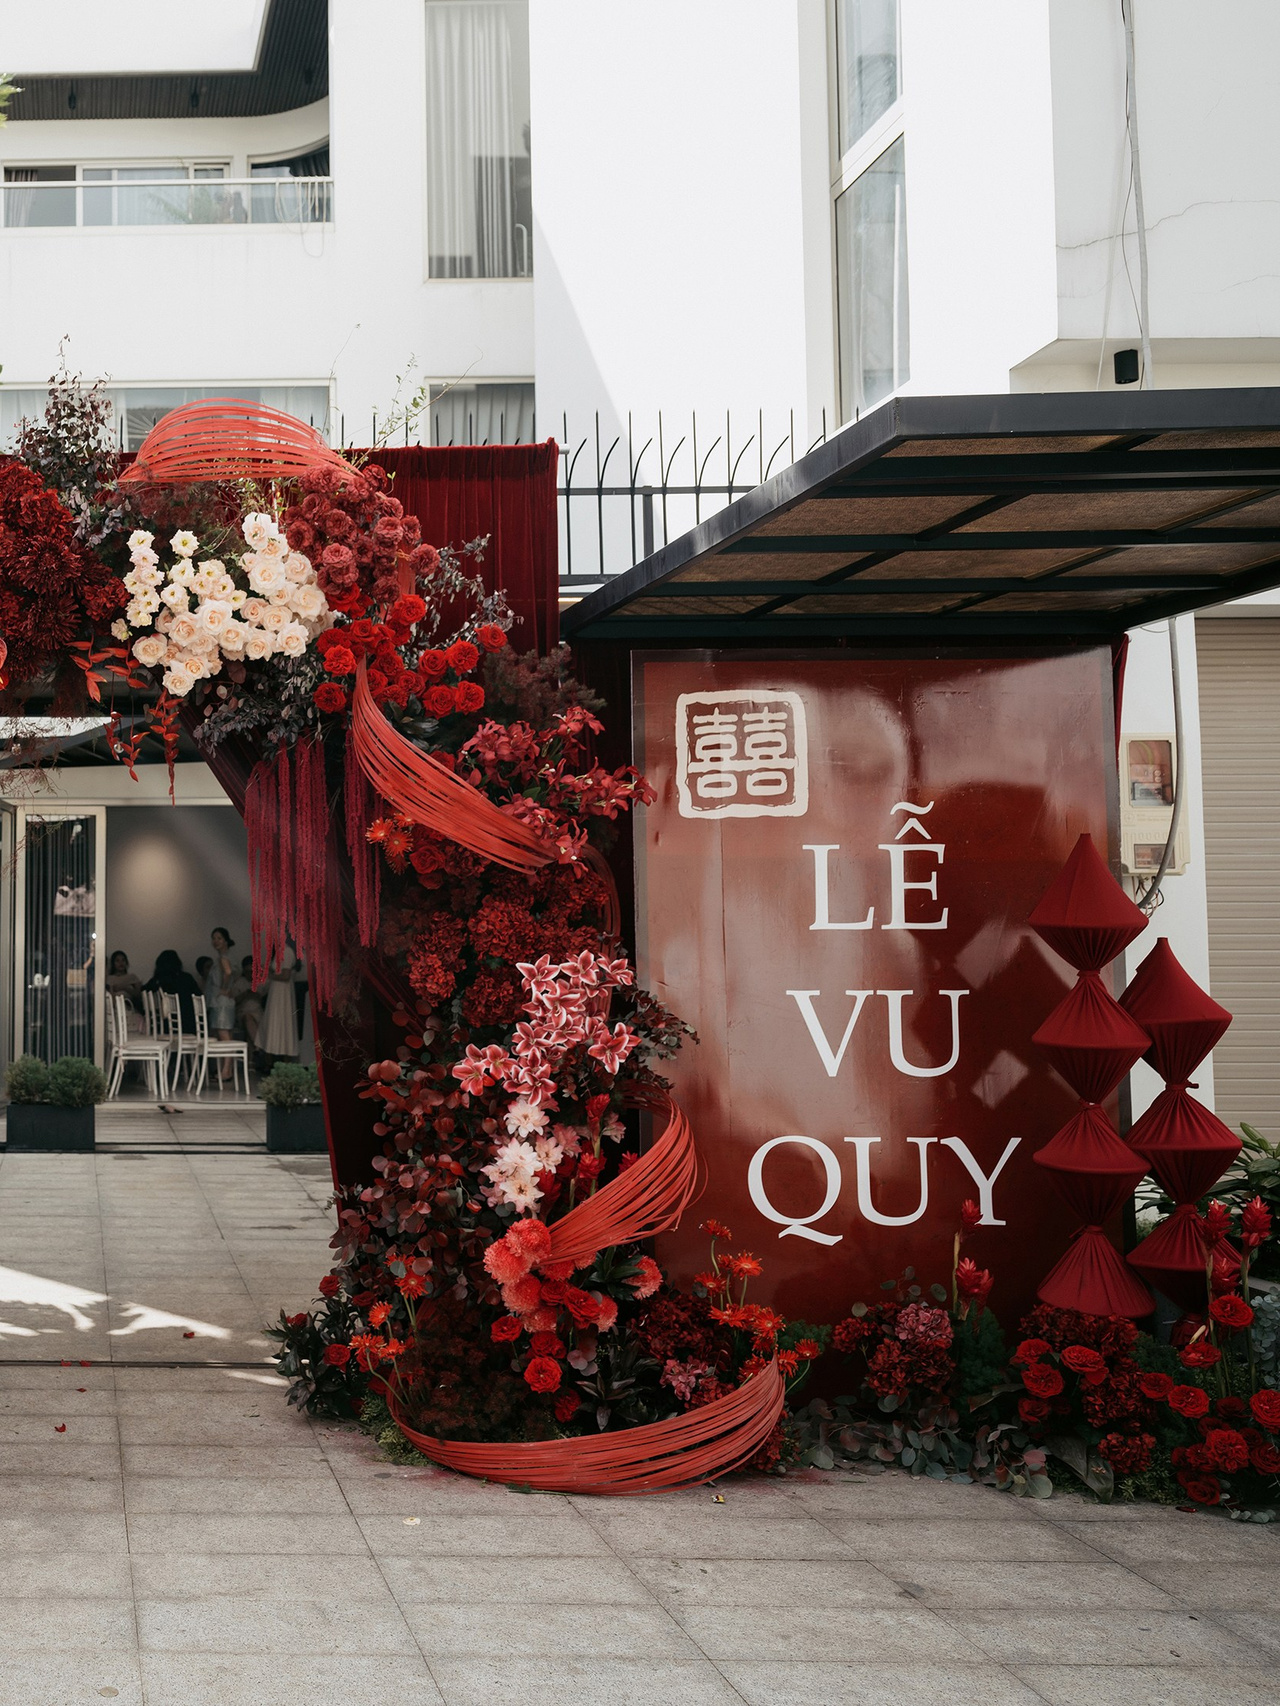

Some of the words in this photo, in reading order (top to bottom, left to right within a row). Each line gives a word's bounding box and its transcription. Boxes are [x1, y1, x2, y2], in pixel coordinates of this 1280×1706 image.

[802, 801, 949, 931] LỄ
[786, 989, 970, 1078] VU
[747, 1135, 1022, 1246] QUY
